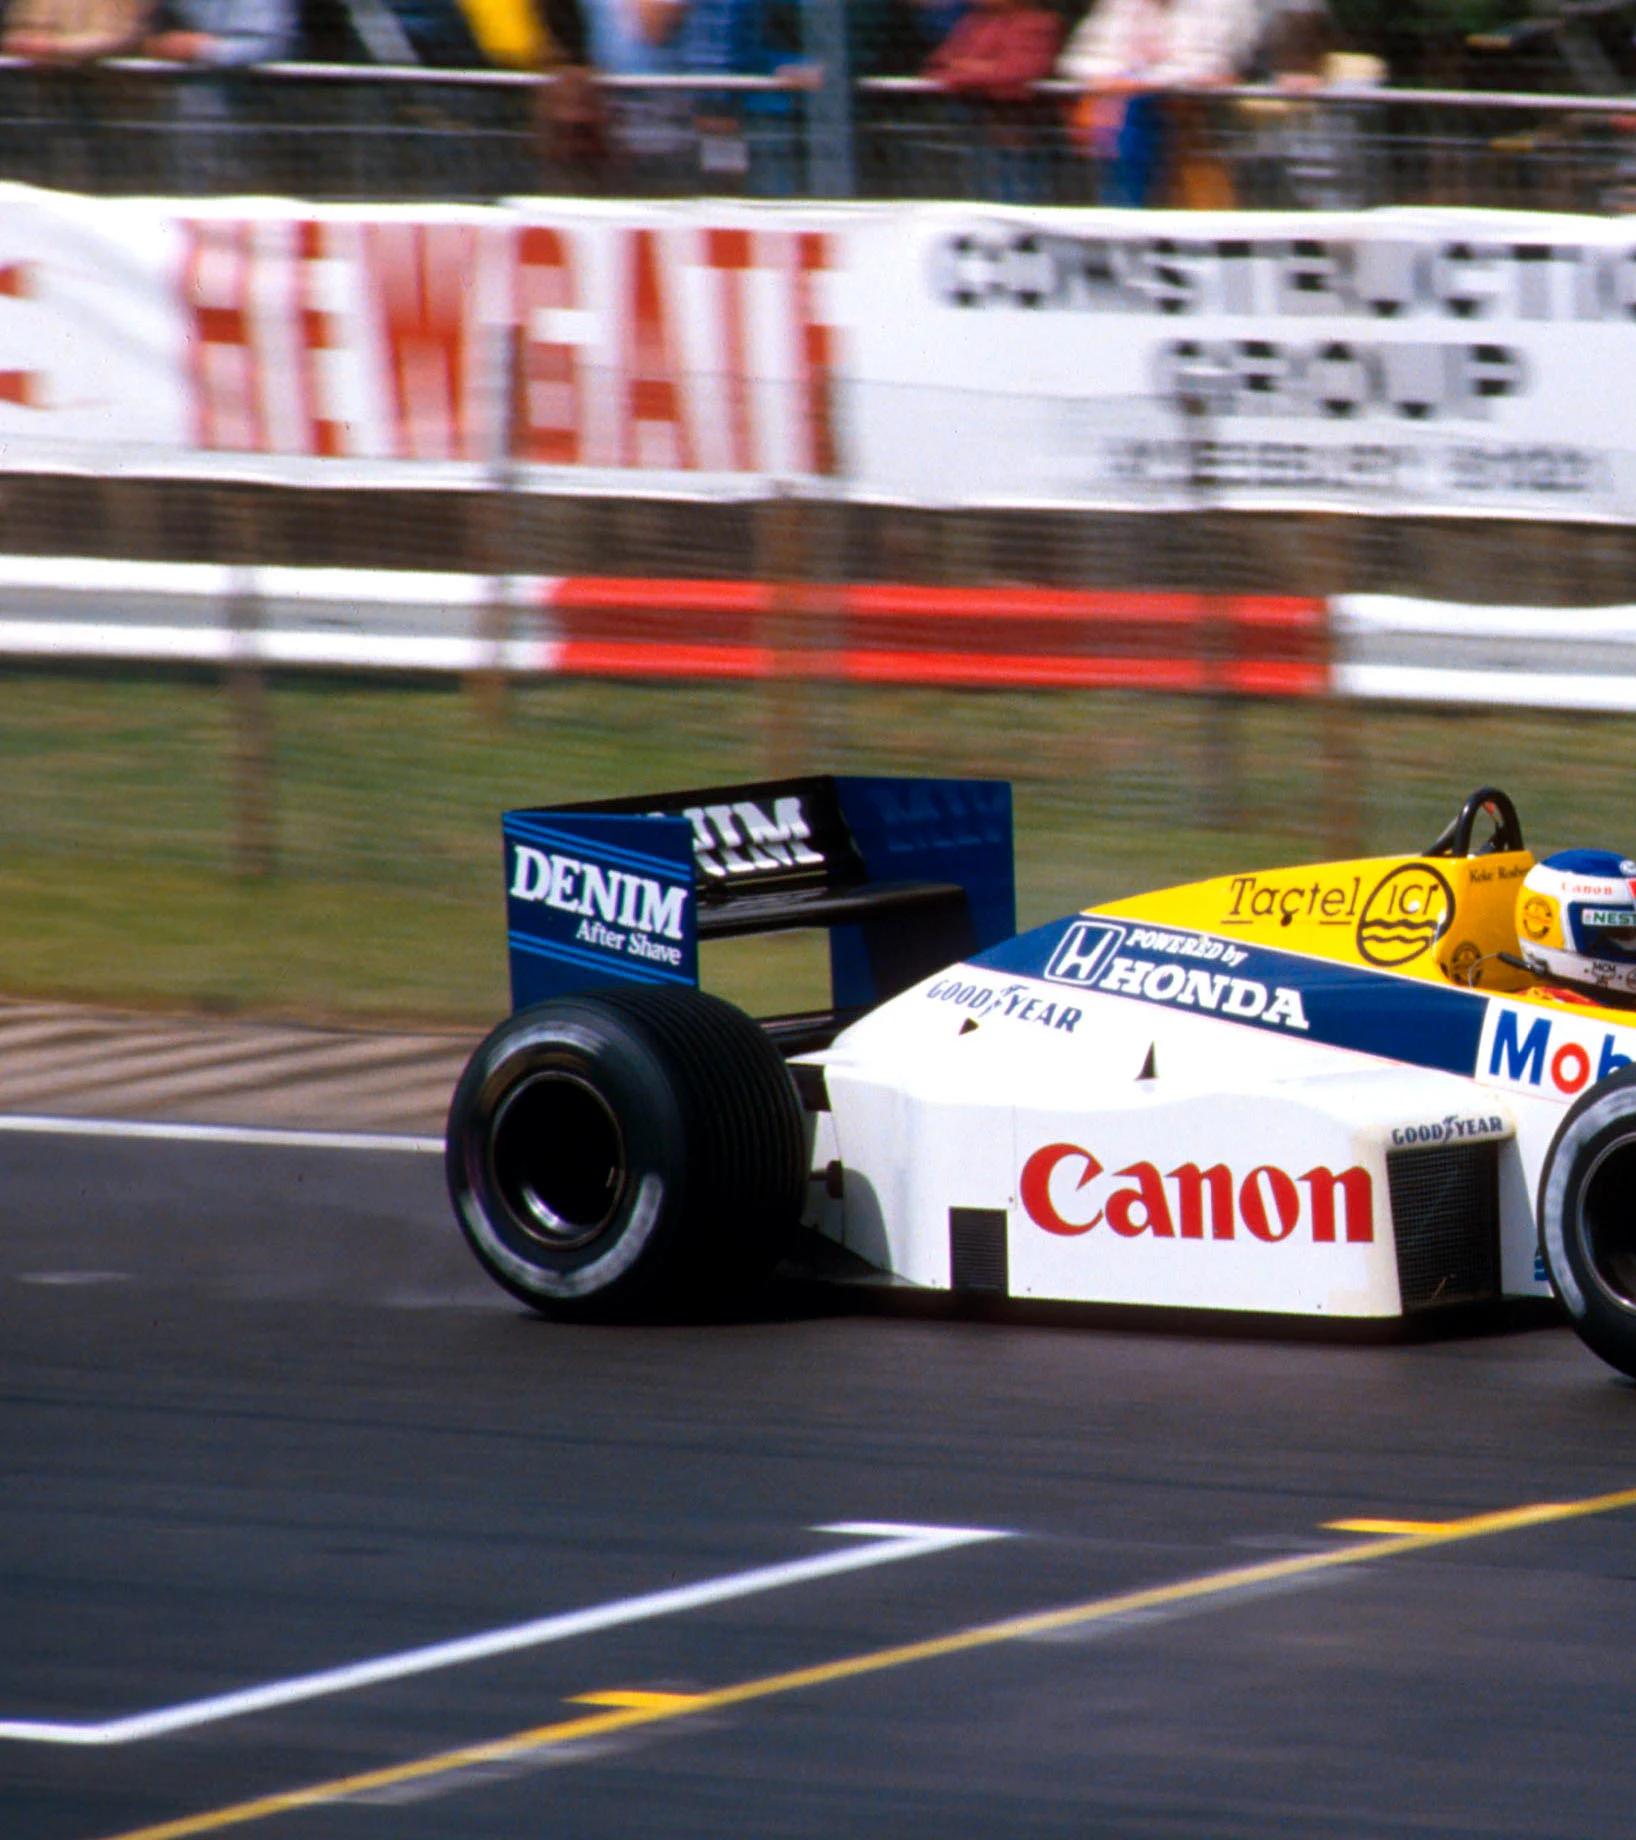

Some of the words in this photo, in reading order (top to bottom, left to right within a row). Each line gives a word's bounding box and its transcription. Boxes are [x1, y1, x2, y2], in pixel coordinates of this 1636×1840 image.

[1156, 339, 1526, 420] GROUP
[511, 846, 688, 940] DENIM
[1228, 876, 1361, 917] Tactel
[1386, 884, 1440, 917] ICI
[1561, 881, 1613, 896] Canon
[576, 918, 625, 952] After
[627, 931, 681, 966] Shave
[1126, 928, 1221, 960] POWERED
[1221, 947, 1248, 968] by
[927, 979, 1083, 1033] GOODYEAR
[1100, 958, 1309, 1029] HONDA
[1391, 1114, 1503, 1146] GOODYEAR
[1020, 1143, 1374, 1243] Canon
